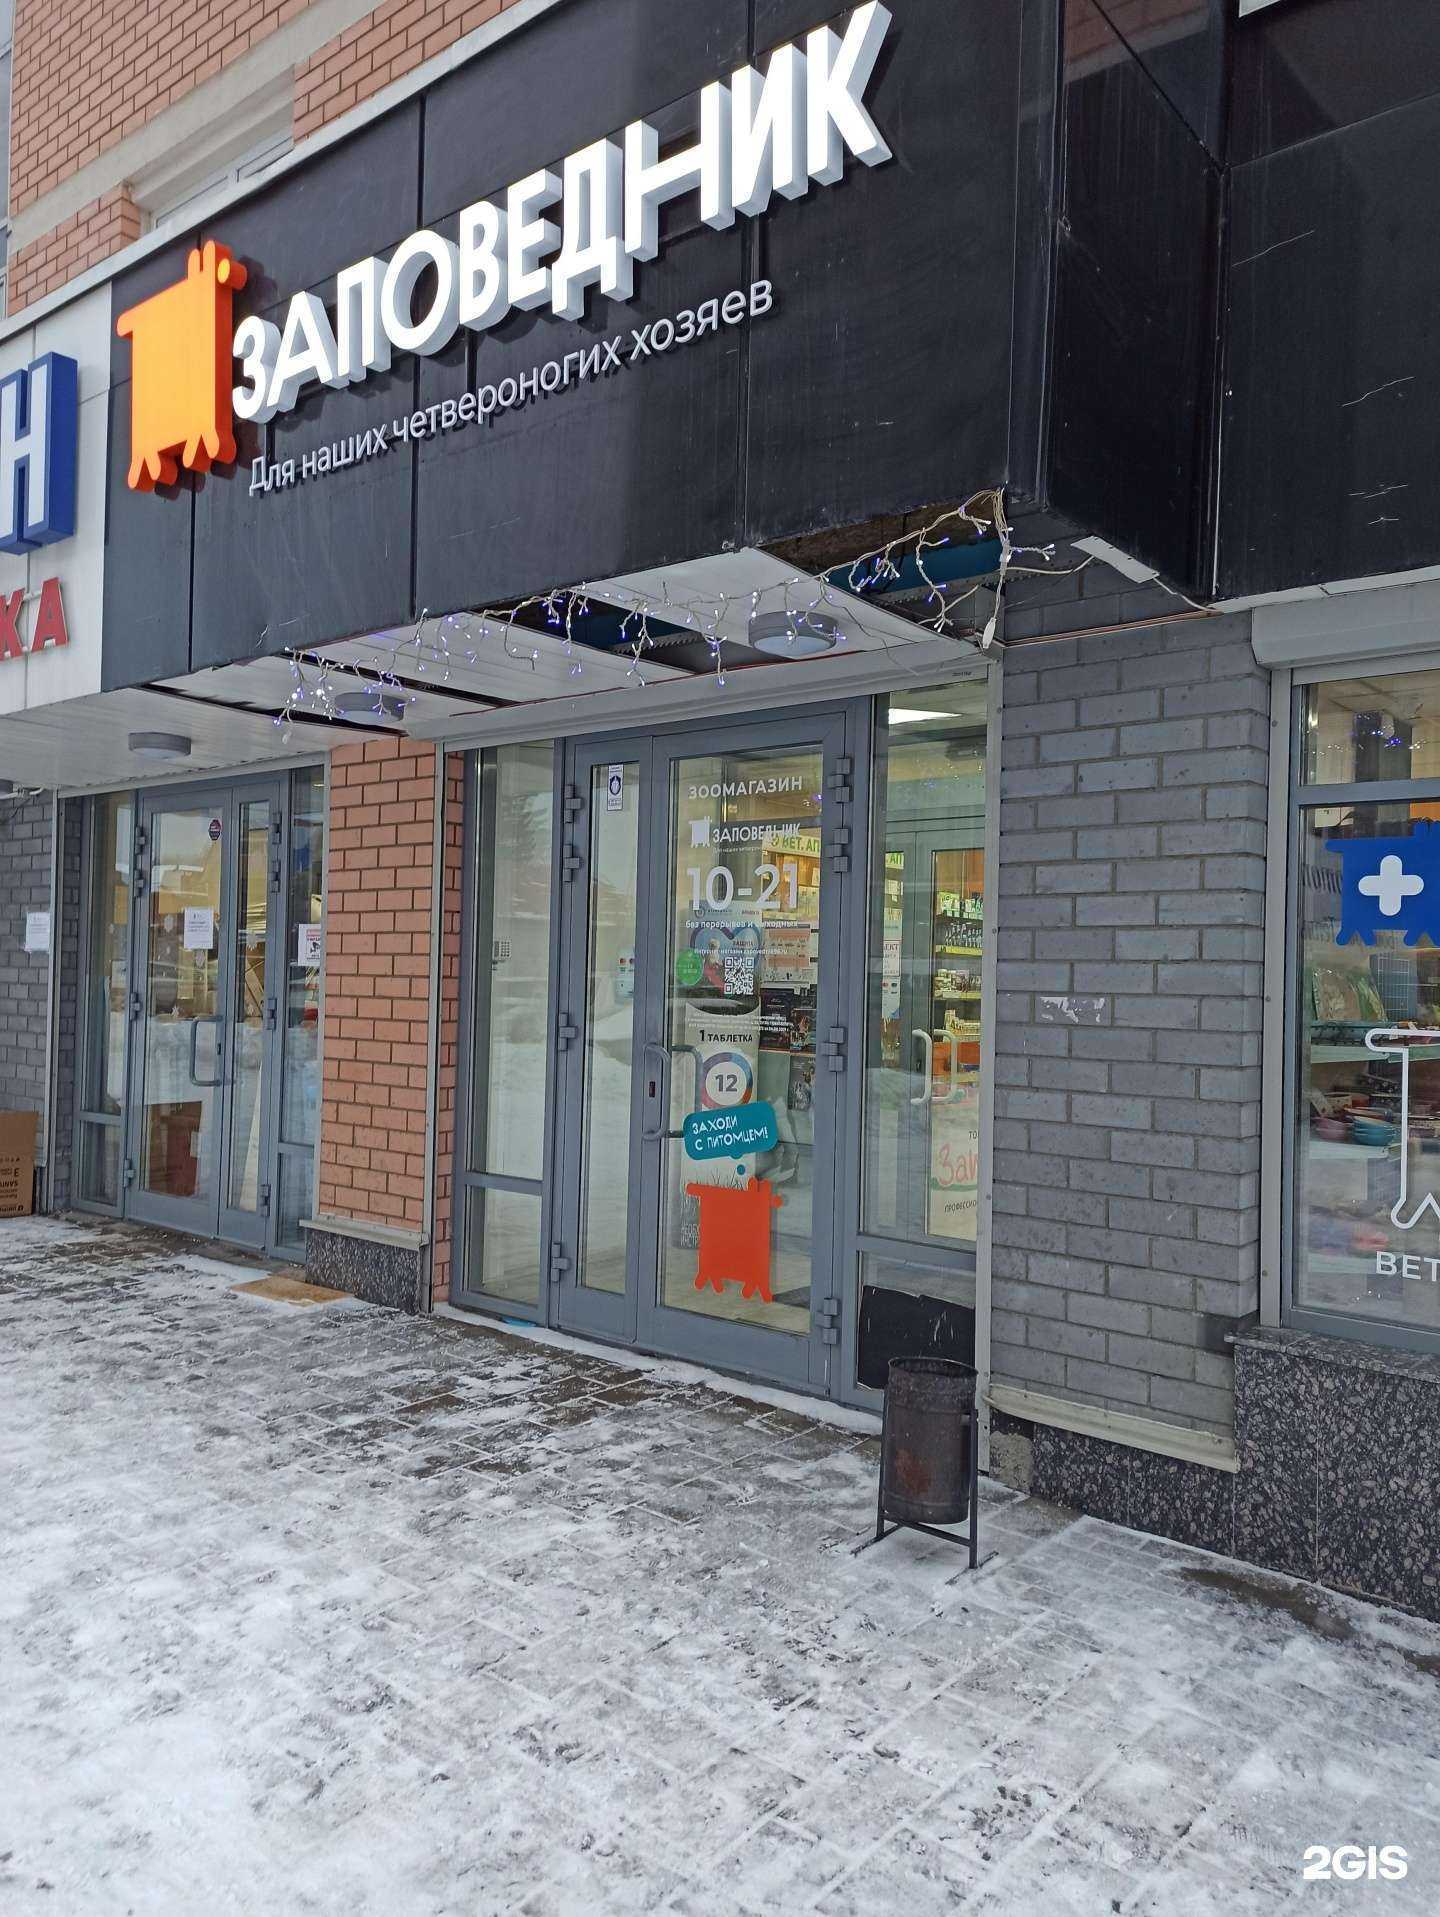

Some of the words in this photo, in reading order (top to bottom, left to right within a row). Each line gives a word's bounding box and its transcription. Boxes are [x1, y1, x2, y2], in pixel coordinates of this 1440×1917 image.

[232, 0, 893, 424] ЗАПОВЕДНИК
[249, 456, 295, 496] Для
[302, 424, 388, 479] наших
[393, 335, 622, 443] четвероногих
[630, 279, 774, 362] хозяев
[688, 776, 803, 799] ЗООМАГАЗИН
[712, 823, 800, 843] ЗАПОВЕДНИК
[687, 863, 798, 911] 10-21
[755, 920, 798, 929] ыходных
[699, 1030, 705, 1042] 1
[707, 1033, 753, 1043] ТАБЛЕТКА
[715, 1074, 738, 1093] 12
[692, 1115, 738, 1135] ЗАХОДИ
[695, 1139, 703, 1151] С
[707, 1126, 768, 1148] ПИТОМЦЕМ!
[1376, 1250, 1440, 1282] ВЕТ
